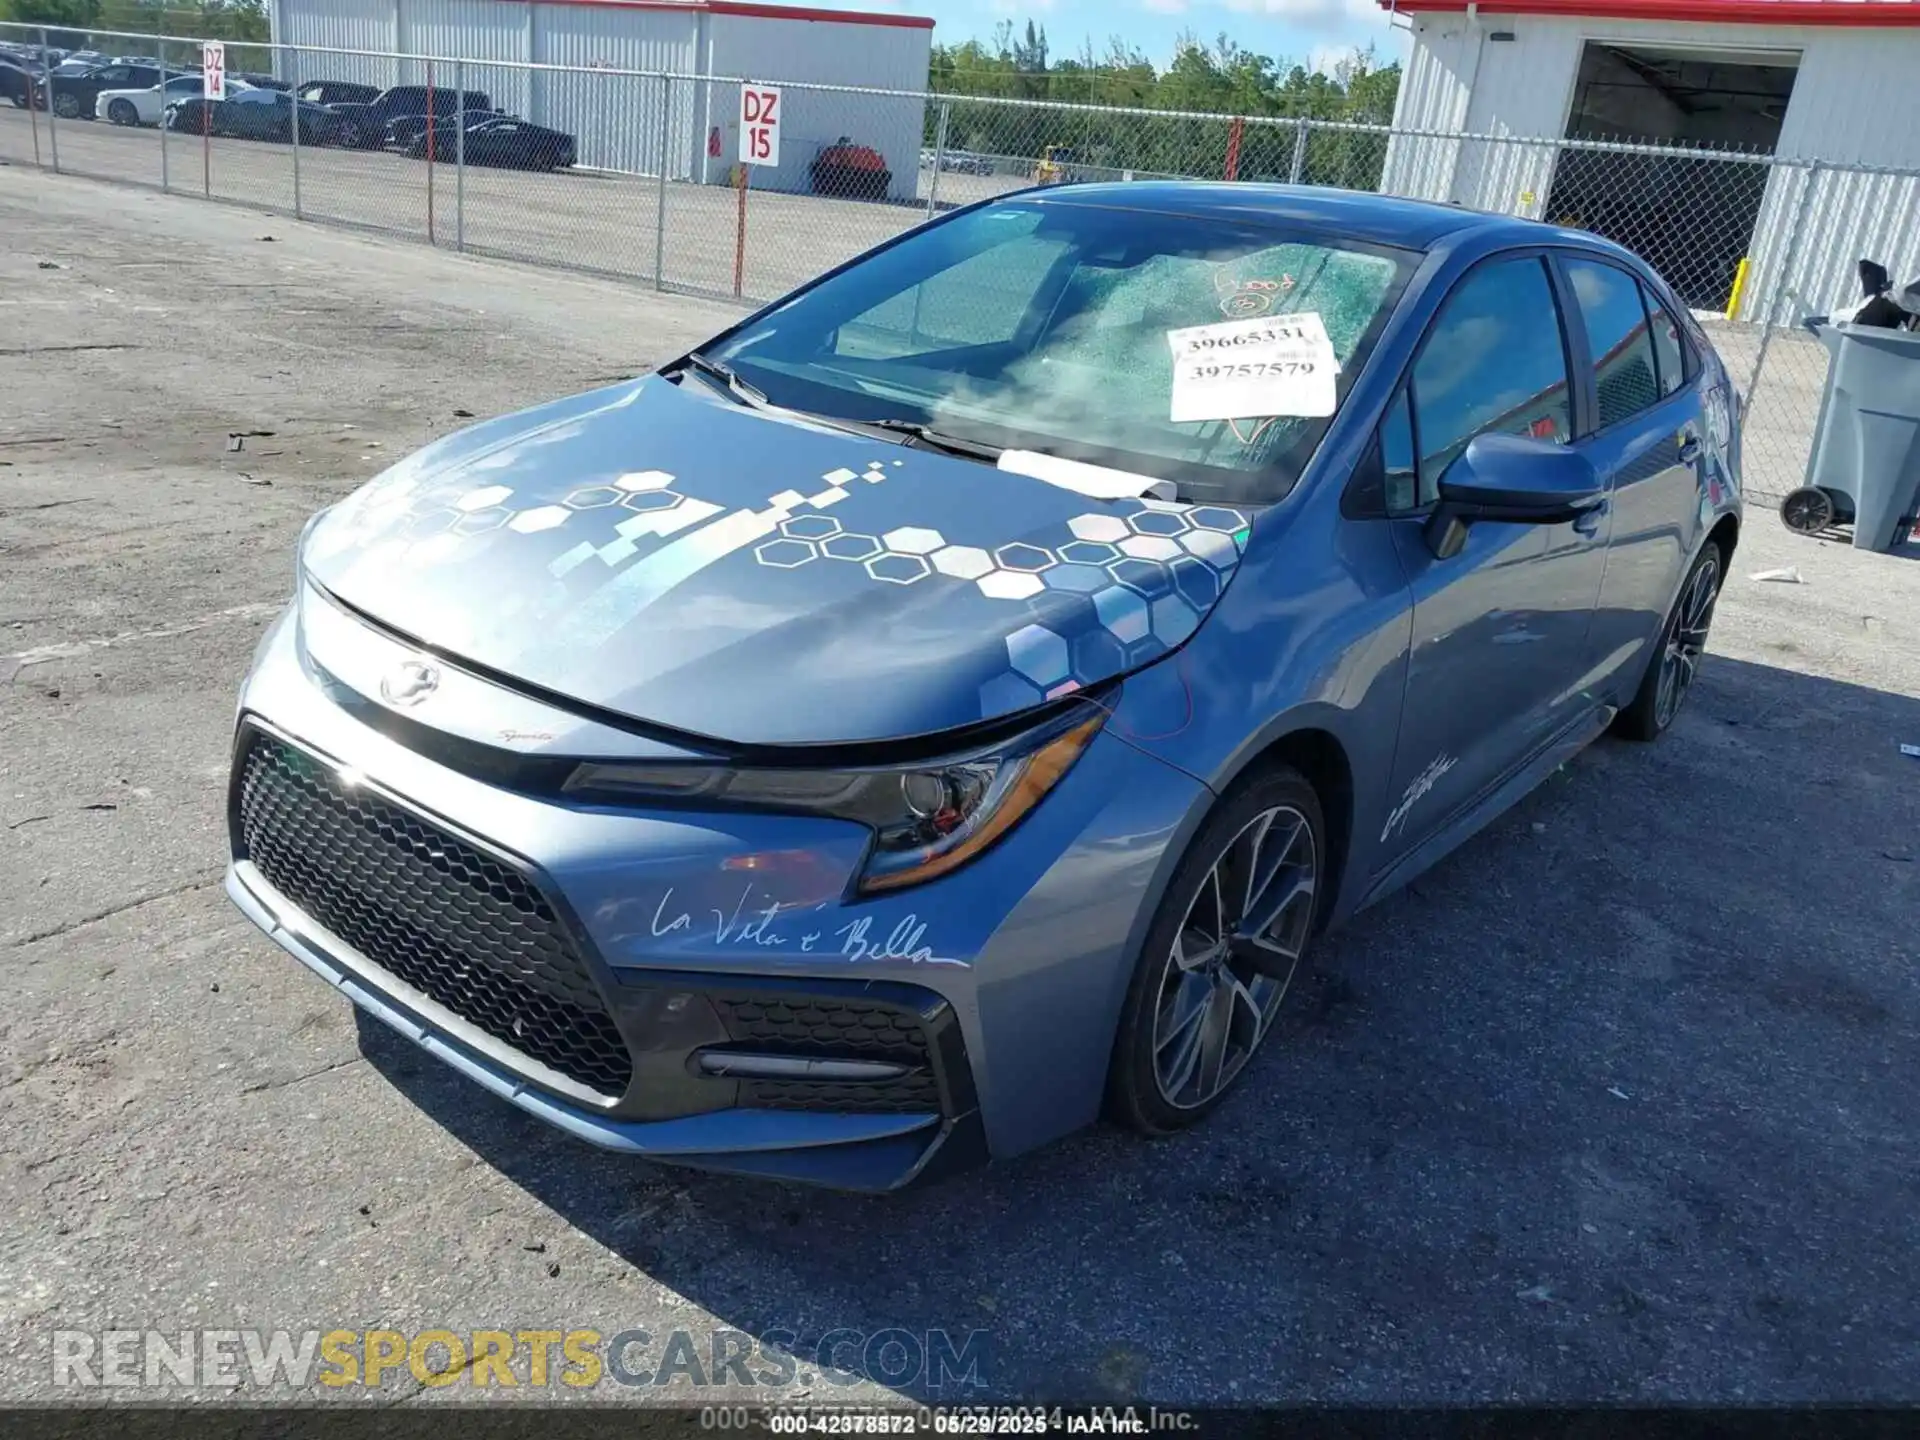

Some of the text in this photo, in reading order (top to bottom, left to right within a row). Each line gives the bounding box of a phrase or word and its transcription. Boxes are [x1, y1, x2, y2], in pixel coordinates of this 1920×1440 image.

[206, 48, 222, 71] DZ
[210, 74, 220, 95] 14
[744, 91, 777, 125] DZ
[749, 127, 770, 158] 15
[1188, 327, 1304, 353] 39665331
[1189, 362, 1315, 380] 39757579
[652, 887, 691, 936] La
[711, 883, 788, 945] Vita
[834, 914, 971, 968] Bella
